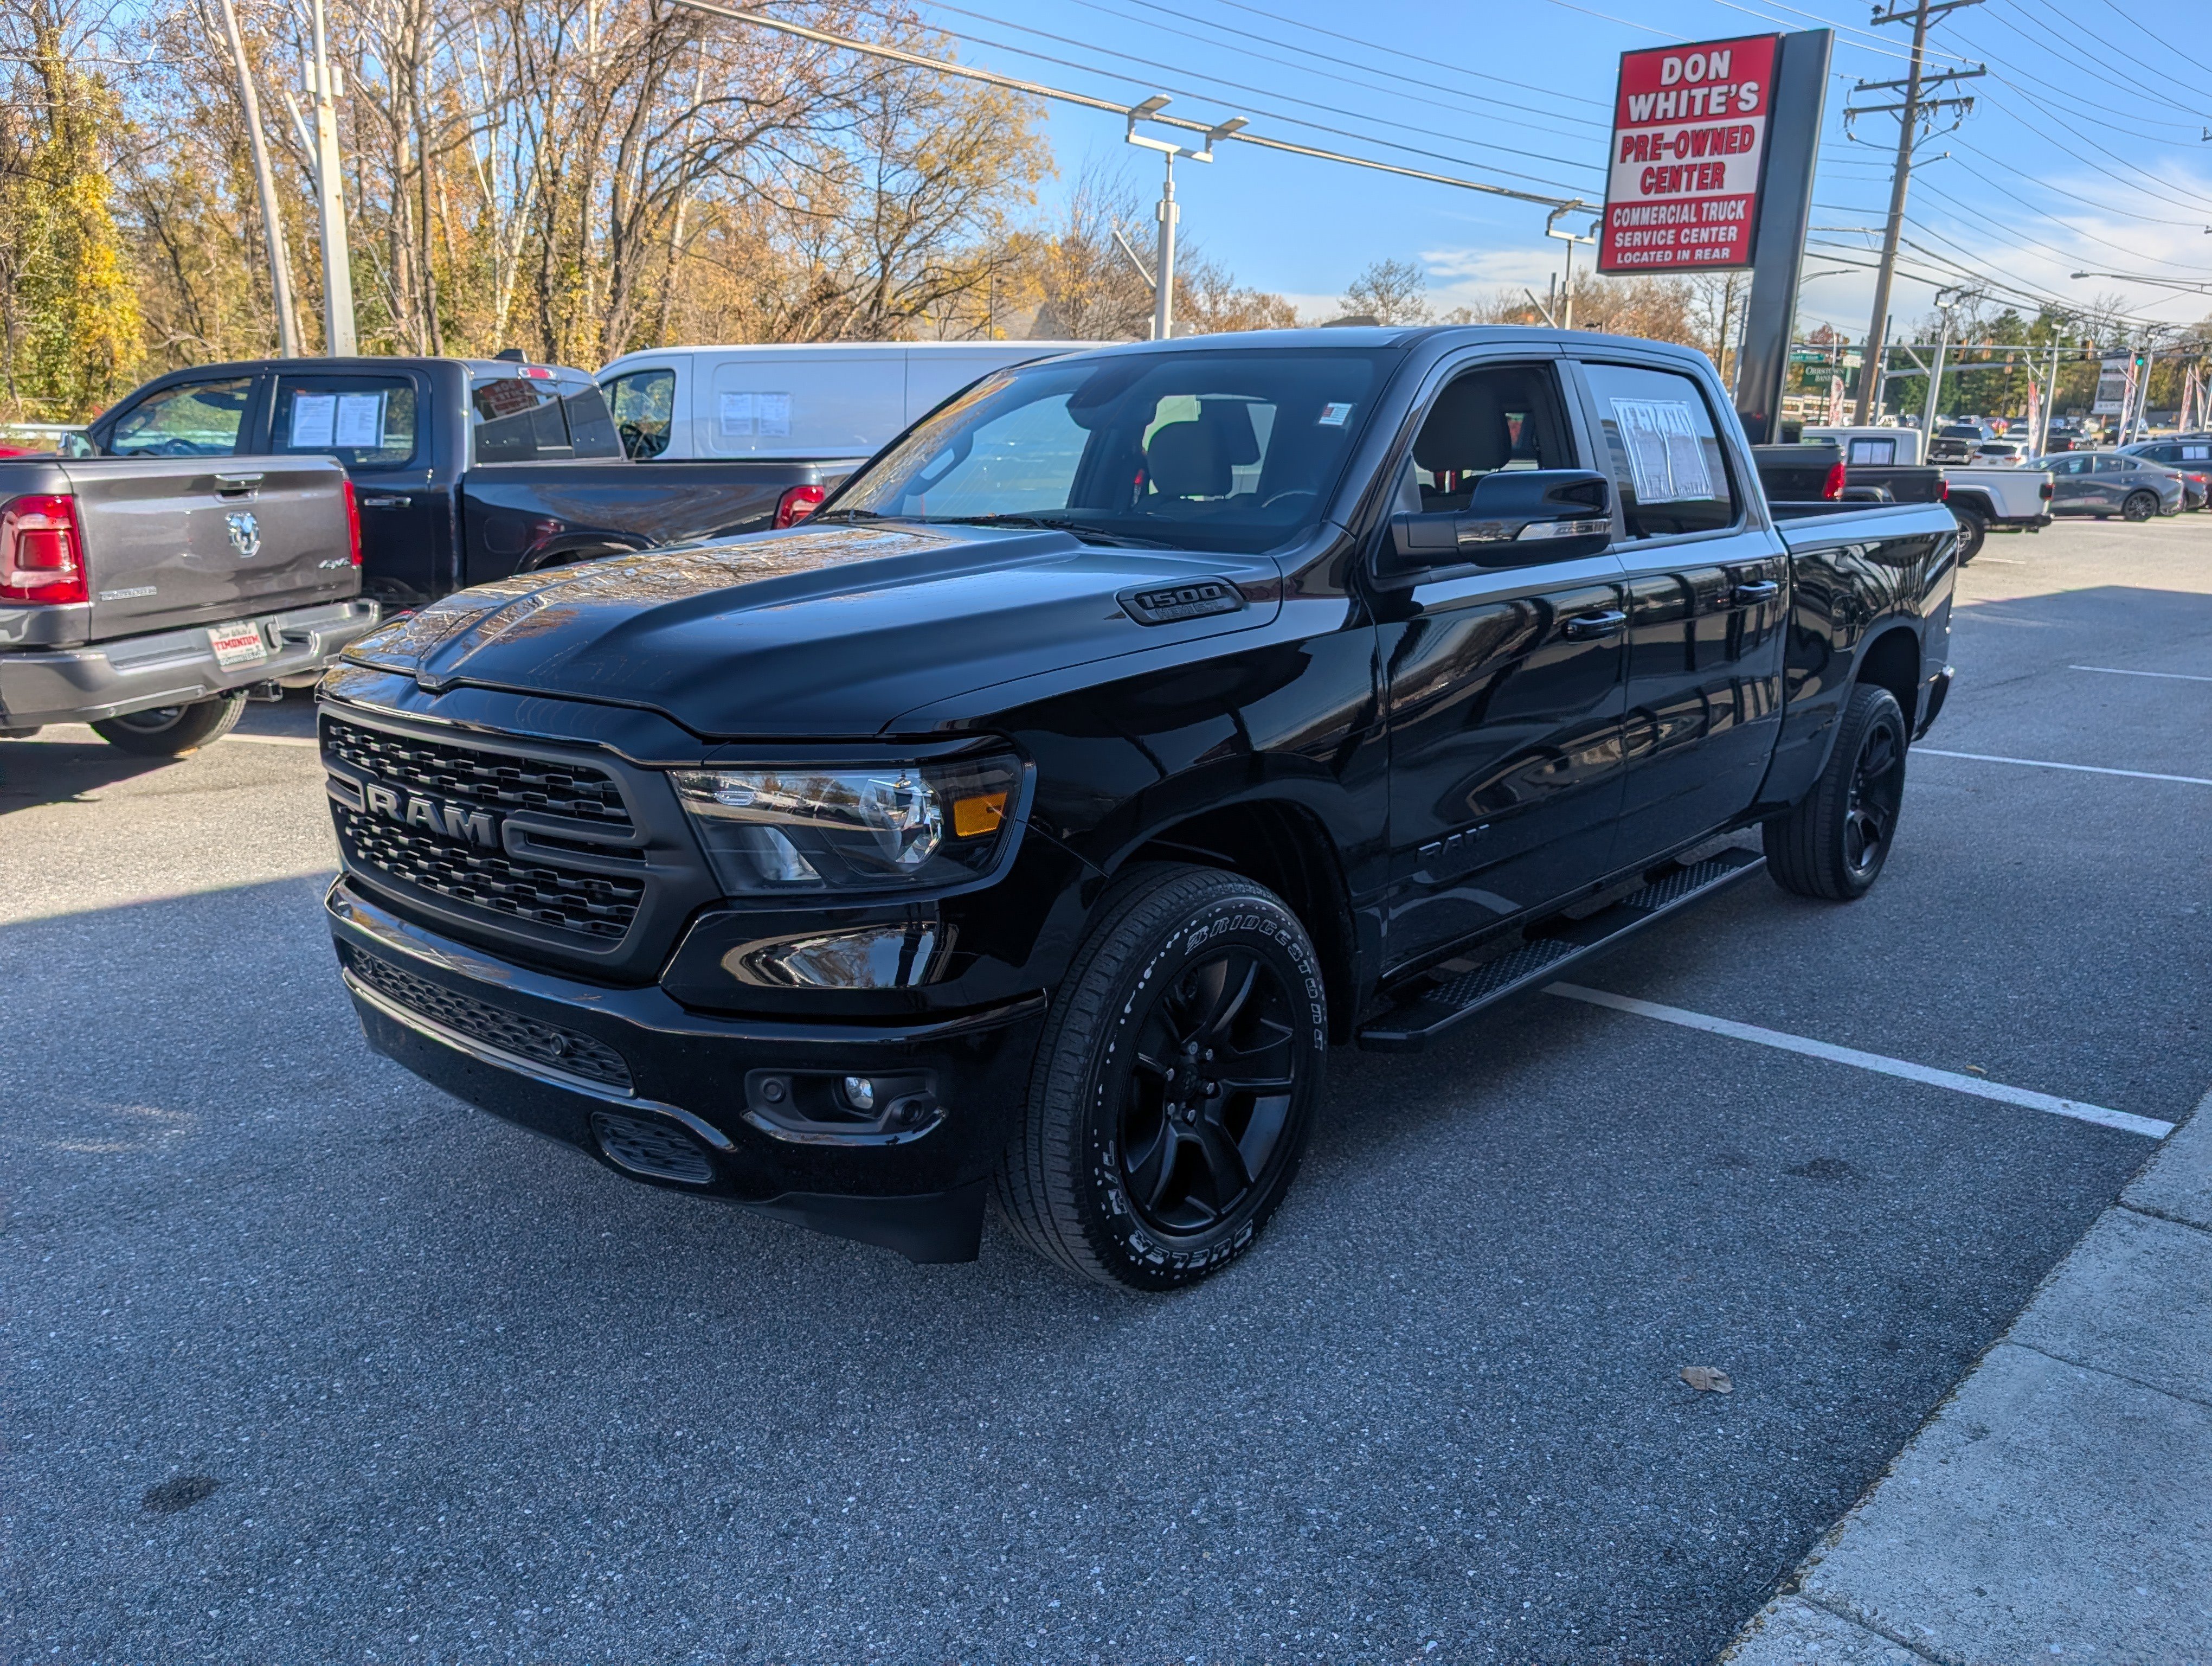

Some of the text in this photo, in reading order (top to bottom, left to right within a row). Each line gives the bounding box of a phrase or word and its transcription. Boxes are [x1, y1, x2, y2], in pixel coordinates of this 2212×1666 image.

[1660, 49, 1732, 86] DON
[1628, 80, 1760, 122] WHITE'S
[1619, 124, 1754, 164] PRE-OWNED
[1640, 161, 1726, 195] CENTER
[1612, 199, 1747, 228] COMMERCIAL TRUCK
[1615, 226, 1738, 248] SERVICE CENTER
[1616, 247, 1731, 264] LOCATED IN REAR
[1140, 585, 1222, 608] 1500
[1155, 604, 1192, 620] HEMI
[213, 634, 260, 651] TIMONIUM
[367, 783, 498, 848] RAM
[1184, 914, 1323, 1051] BRIDGESTONE
[1129, 1218, 1253, 1269] DUELER
